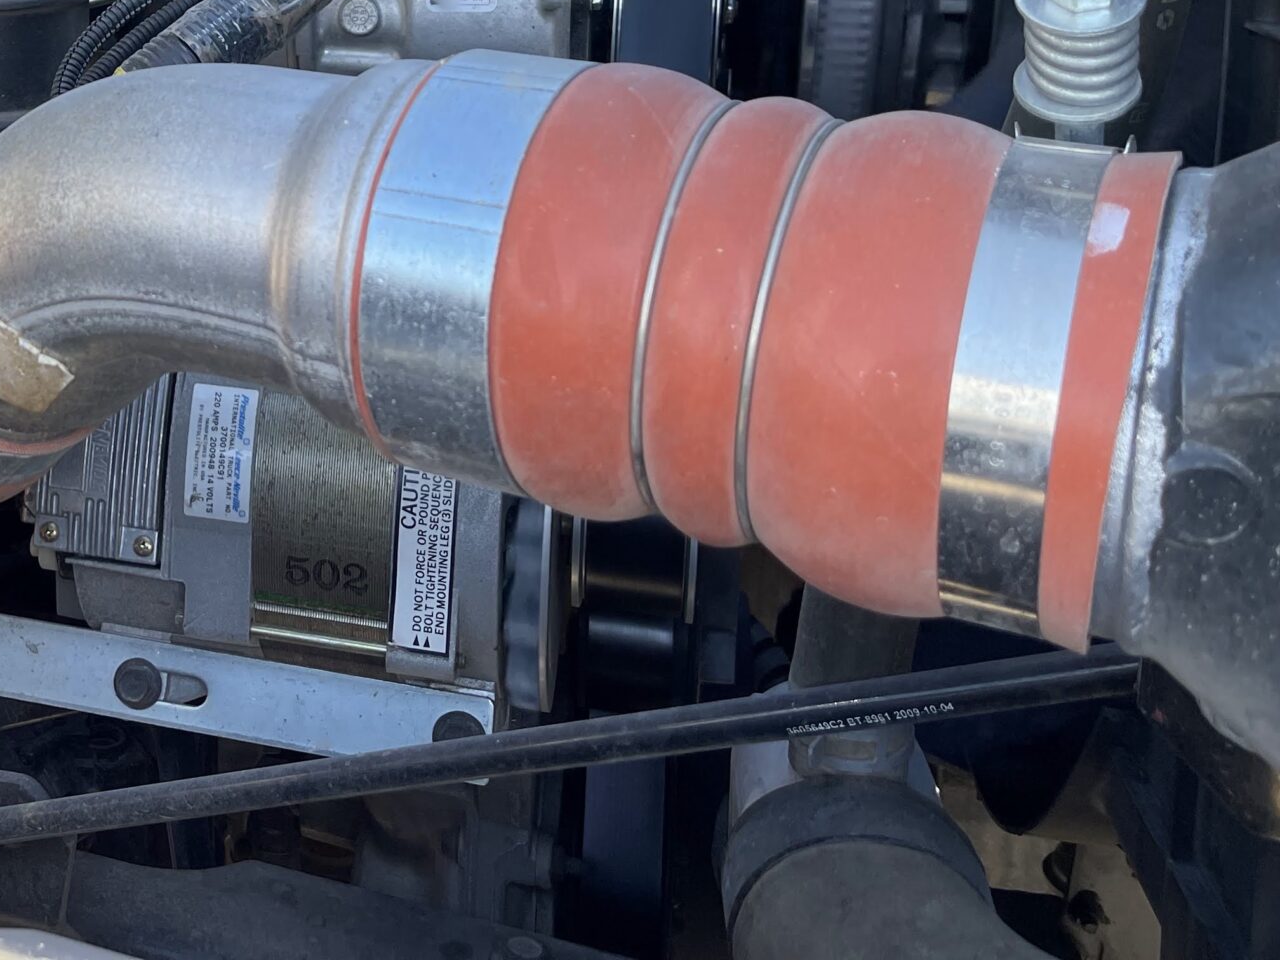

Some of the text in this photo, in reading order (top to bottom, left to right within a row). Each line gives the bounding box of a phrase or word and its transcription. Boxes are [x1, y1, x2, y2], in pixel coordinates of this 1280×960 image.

[214, 392, 222, 408] 220
[211, 410, 219, 431] AMPS
[228, 394, 240, 450] INTERNATIONAL
[217, 426, 228, 480] 3700149C91
[226, 456, 234, 478] TRUCK
[232, 394, 249, 513] Prestolite Leece-Neville
[207, 474, 215, 484] 14
[206, 487, 214, 513] VOLTS
[400, 469, 420, 530] CAUTI
[418, 484, 430, 525] POUND
[417, 530, 427, 545] OR
[424, 476, 442, 633] BOLT TIGHTENING SEQUENC
[415, 550, 425, 585] FORCE
[435, 477, 453, 635] END MOUNTING LEG (3) SLID
[285, 555, 369, 593] 502
[413, 588, 424, 611] NOT
[412, 616, 422, 632] DO
